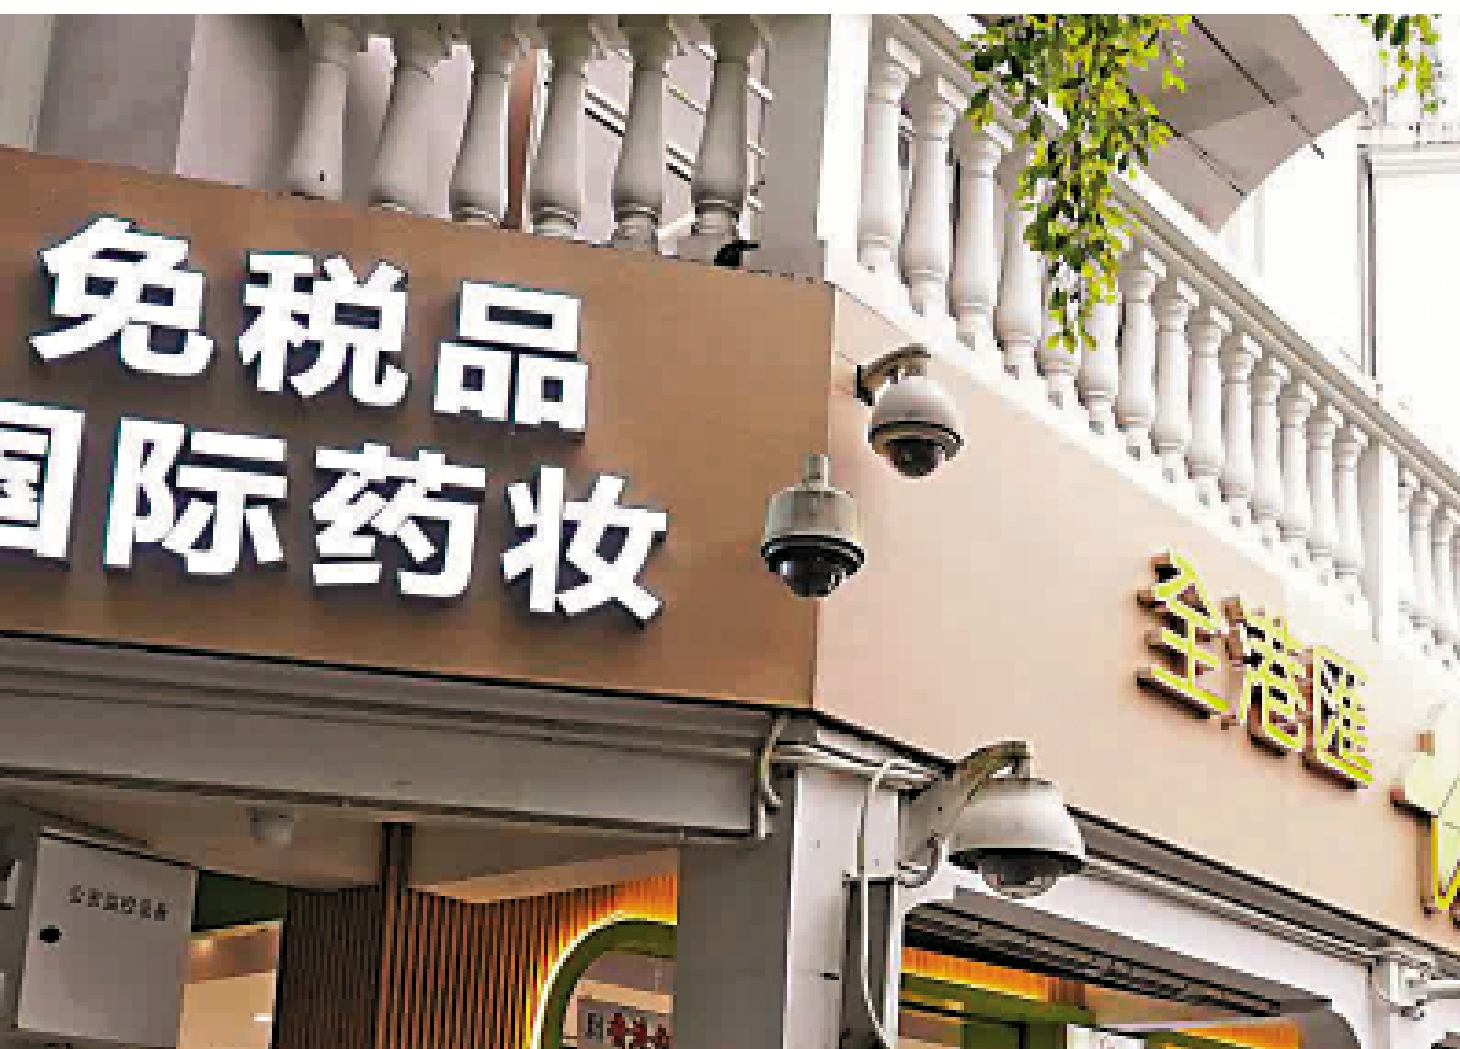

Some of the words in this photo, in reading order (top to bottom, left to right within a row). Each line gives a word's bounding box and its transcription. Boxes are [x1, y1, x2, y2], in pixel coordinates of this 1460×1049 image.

[28, 215, 591, 438] 免税品
[1140, 549, 1375, 788] 全港匯
